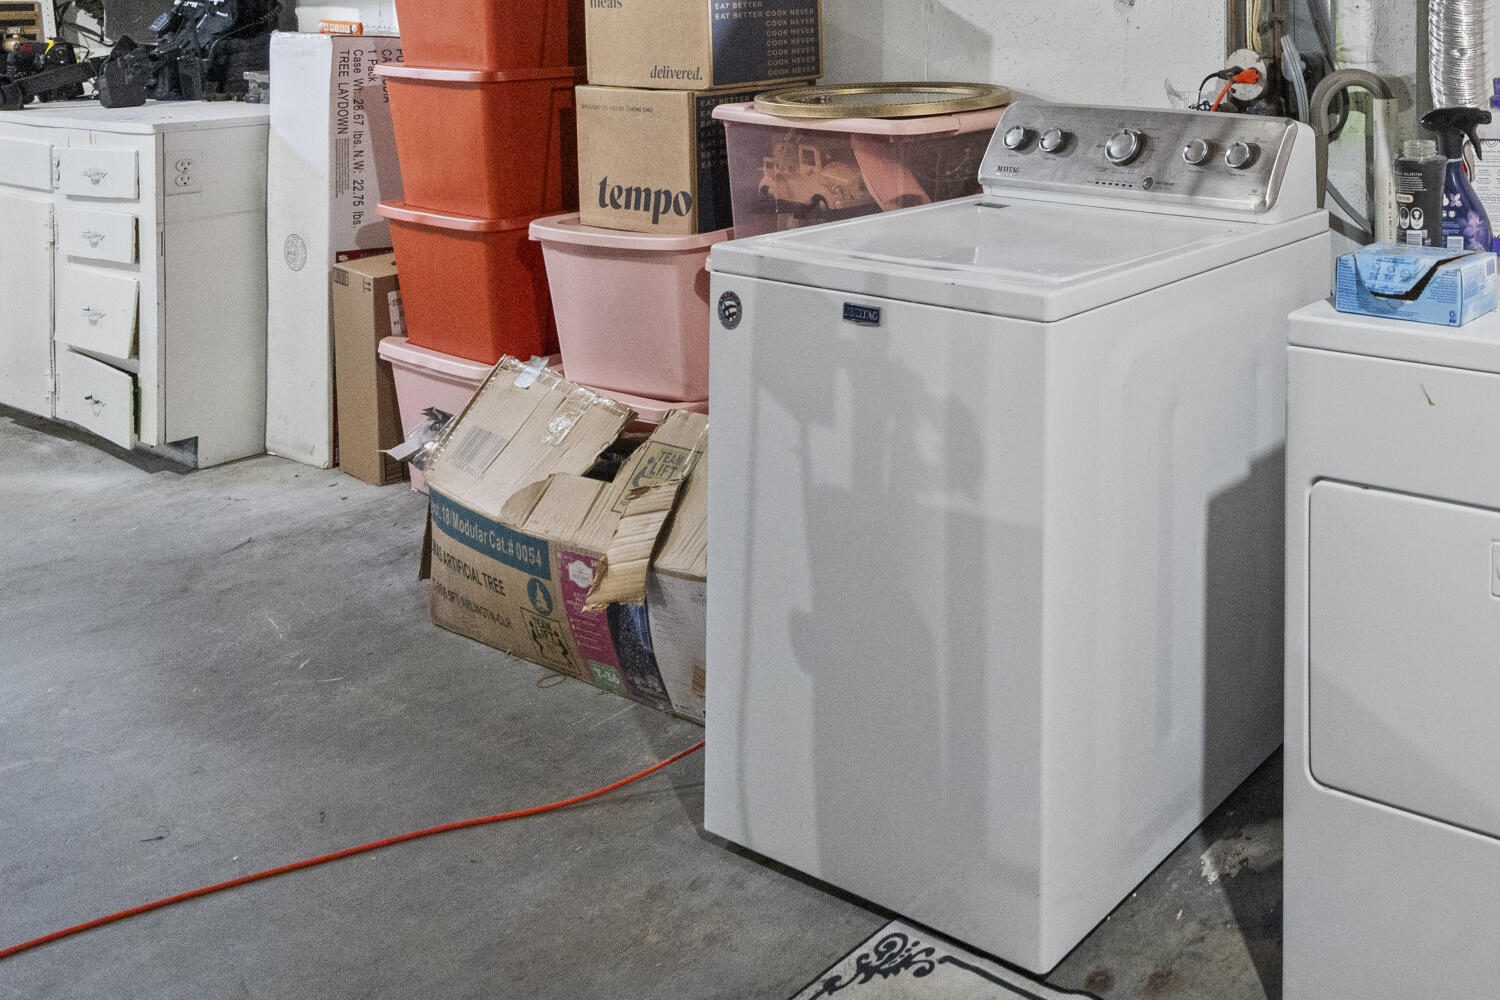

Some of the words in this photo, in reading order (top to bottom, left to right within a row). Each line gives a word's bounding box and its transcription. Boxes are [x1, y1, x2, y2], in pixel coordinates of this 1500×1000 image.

[733, 11, 762, 19] BETTER
[338, 49, 350, 77] TREE
[353, 49, 364, 74] Case
[650, 65, 703, 81] delivered.
[337, 82, 349, 135] LAYDOWN
[353, 99, 364, 126] 28.67
[353, 130, 364, 148] lbs.
[353, 180, 364, 207] 22.75
[598, 176, 692, 225] tempo
[353, 211, 364, 229] lbs.
[649, 462, 678, 479] LIFT
[658, 451, 687, 467] TEAM
[516, 542, 542, 567] 0054
[443, 551, 482, 586] ARTIFICIAL
[481, 572, 506, 597] TREE
